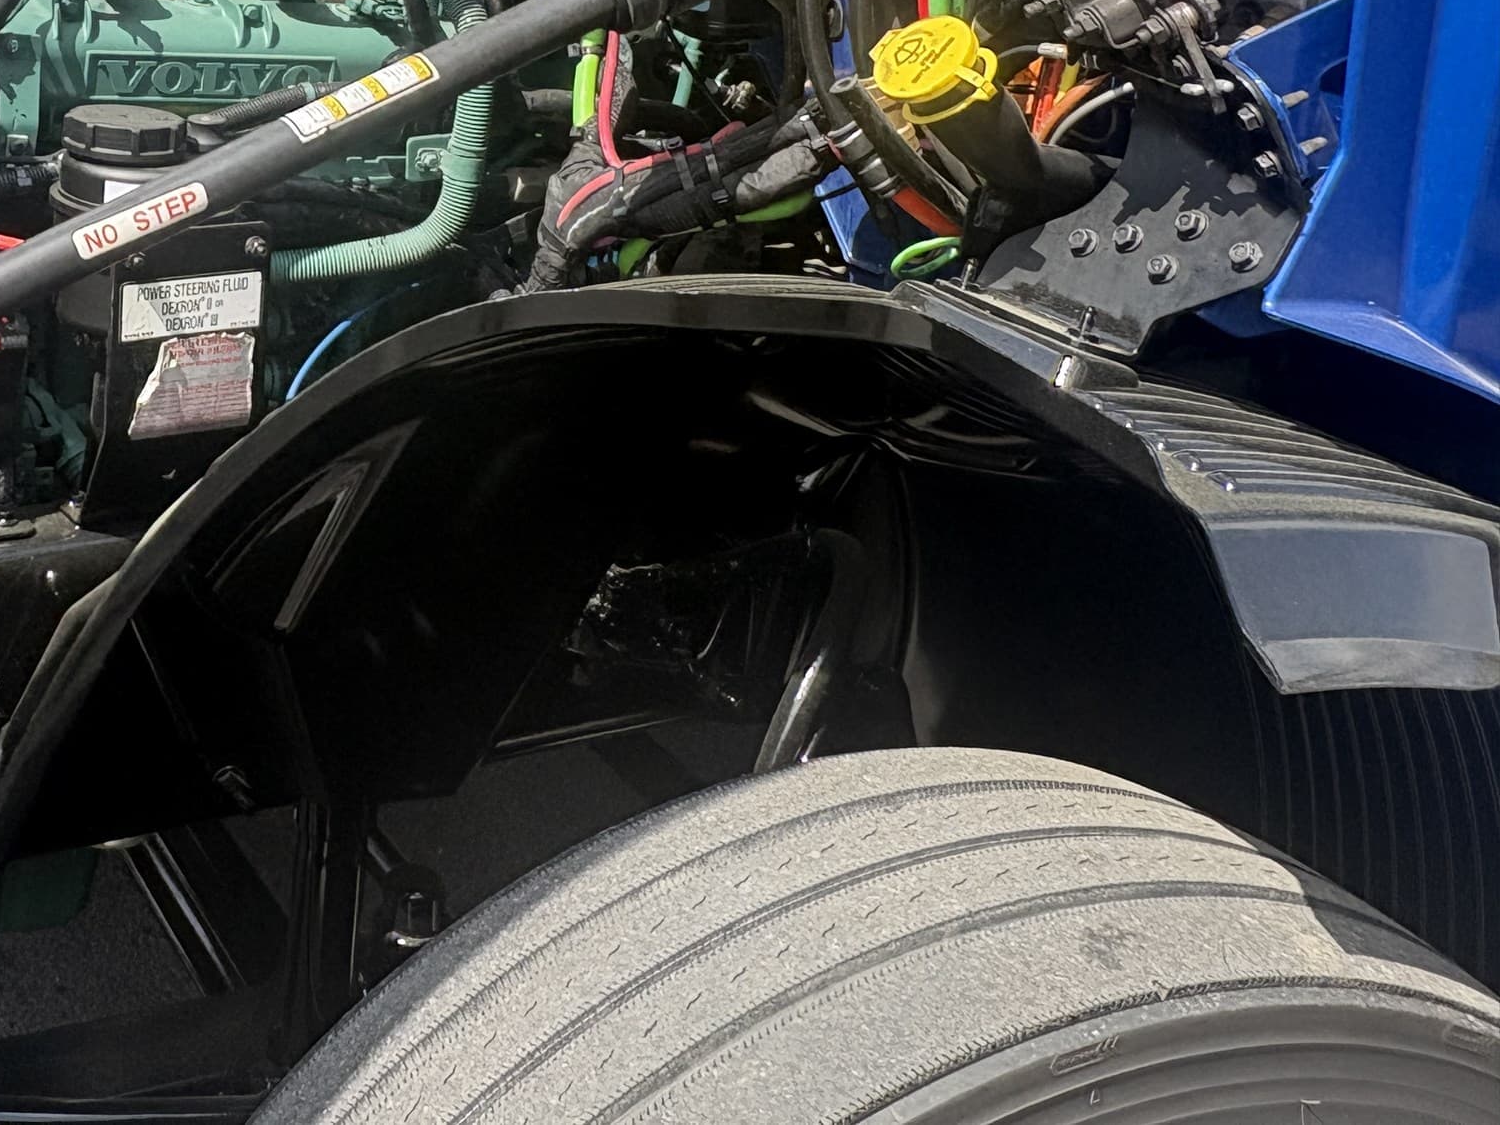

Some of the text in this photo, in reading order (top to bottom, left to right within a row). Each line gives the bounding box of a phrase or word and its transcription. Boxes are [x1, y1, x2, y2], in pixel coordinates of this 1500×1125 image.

[97, 59, 323, 97] VOLVO
[83, 190, 197, 254] NO STEP
[136, 276, 249, 302] POWER STEERING FLUID
